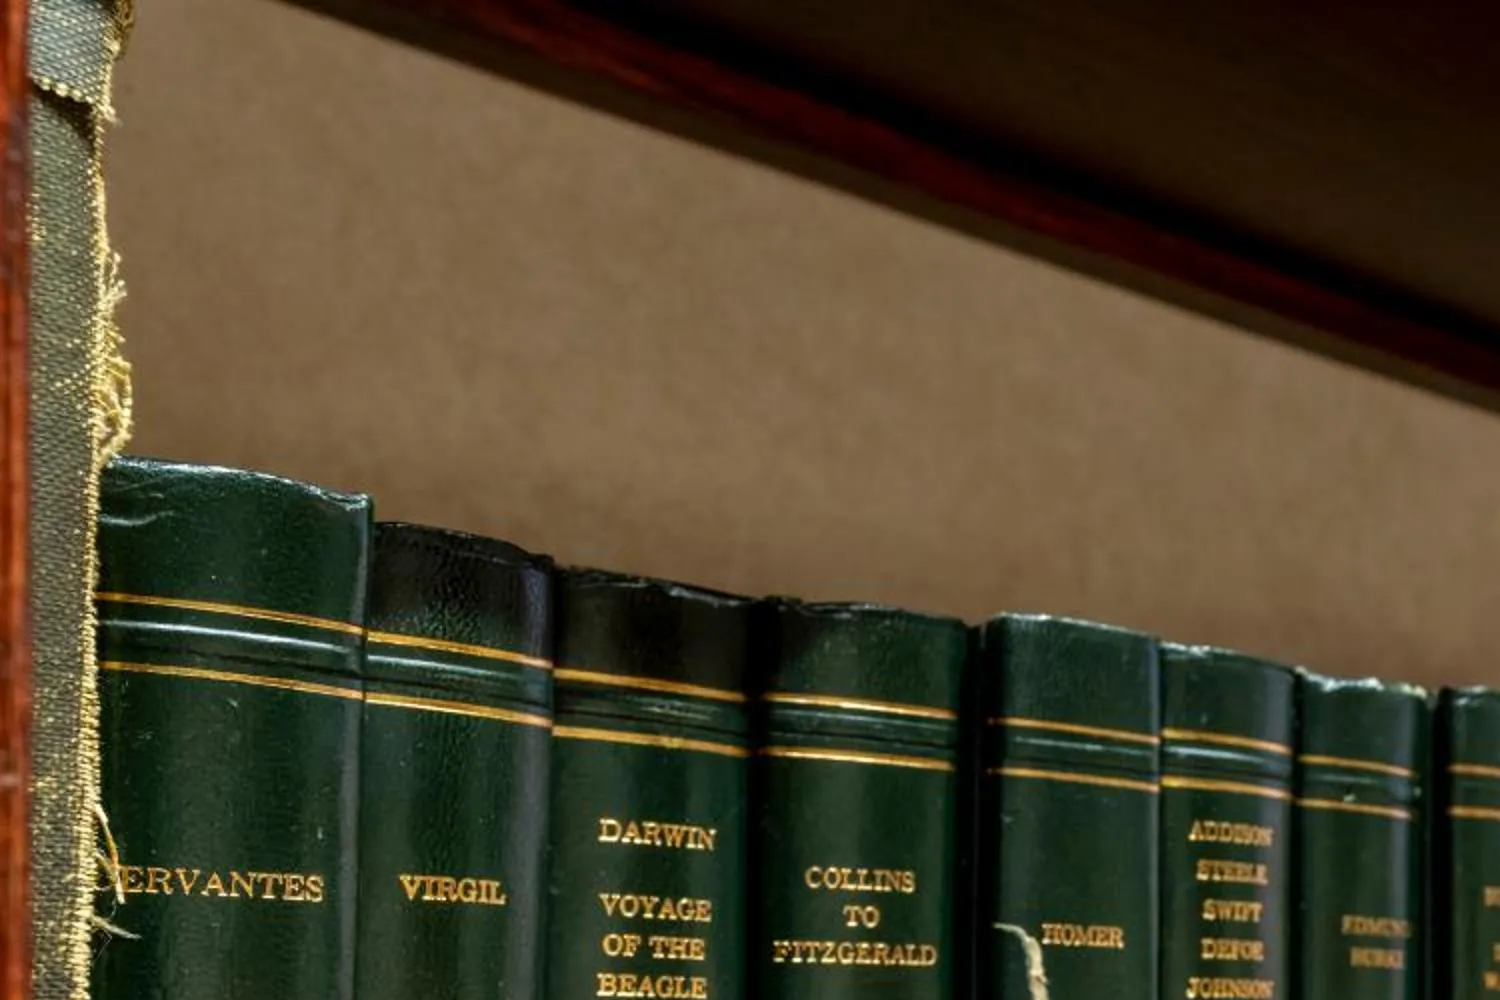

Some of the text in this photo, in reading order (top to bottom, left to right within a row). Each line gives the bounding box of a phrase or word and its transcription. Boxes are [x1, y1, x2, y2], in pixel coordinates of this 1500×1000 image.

[598, 818, 716, 850] DARWIN
[1188, 820, 1274, 847] ADDISON
[118, 865, 326, 903] ERVANTES
[398, 873, 507, 905] VIRGIL
[805, 866, 915, 893] COLLINS
[598, 894, 712, 923] VOYAGE
[843, 905, 880, 928] TO
[1202, 899, 1263, 922] SWIFT
[602, 934, 706, 961] OF THE
[1041, 923, 1125, 949] HOMER
[1201, 938, 1264, 961] DEFOE
[772, 940, 937, 967] FITZGERALD
[596, 972, 709, 1000] BEAGLE
[1186, 977, 1274, 1000] JOHNSON
